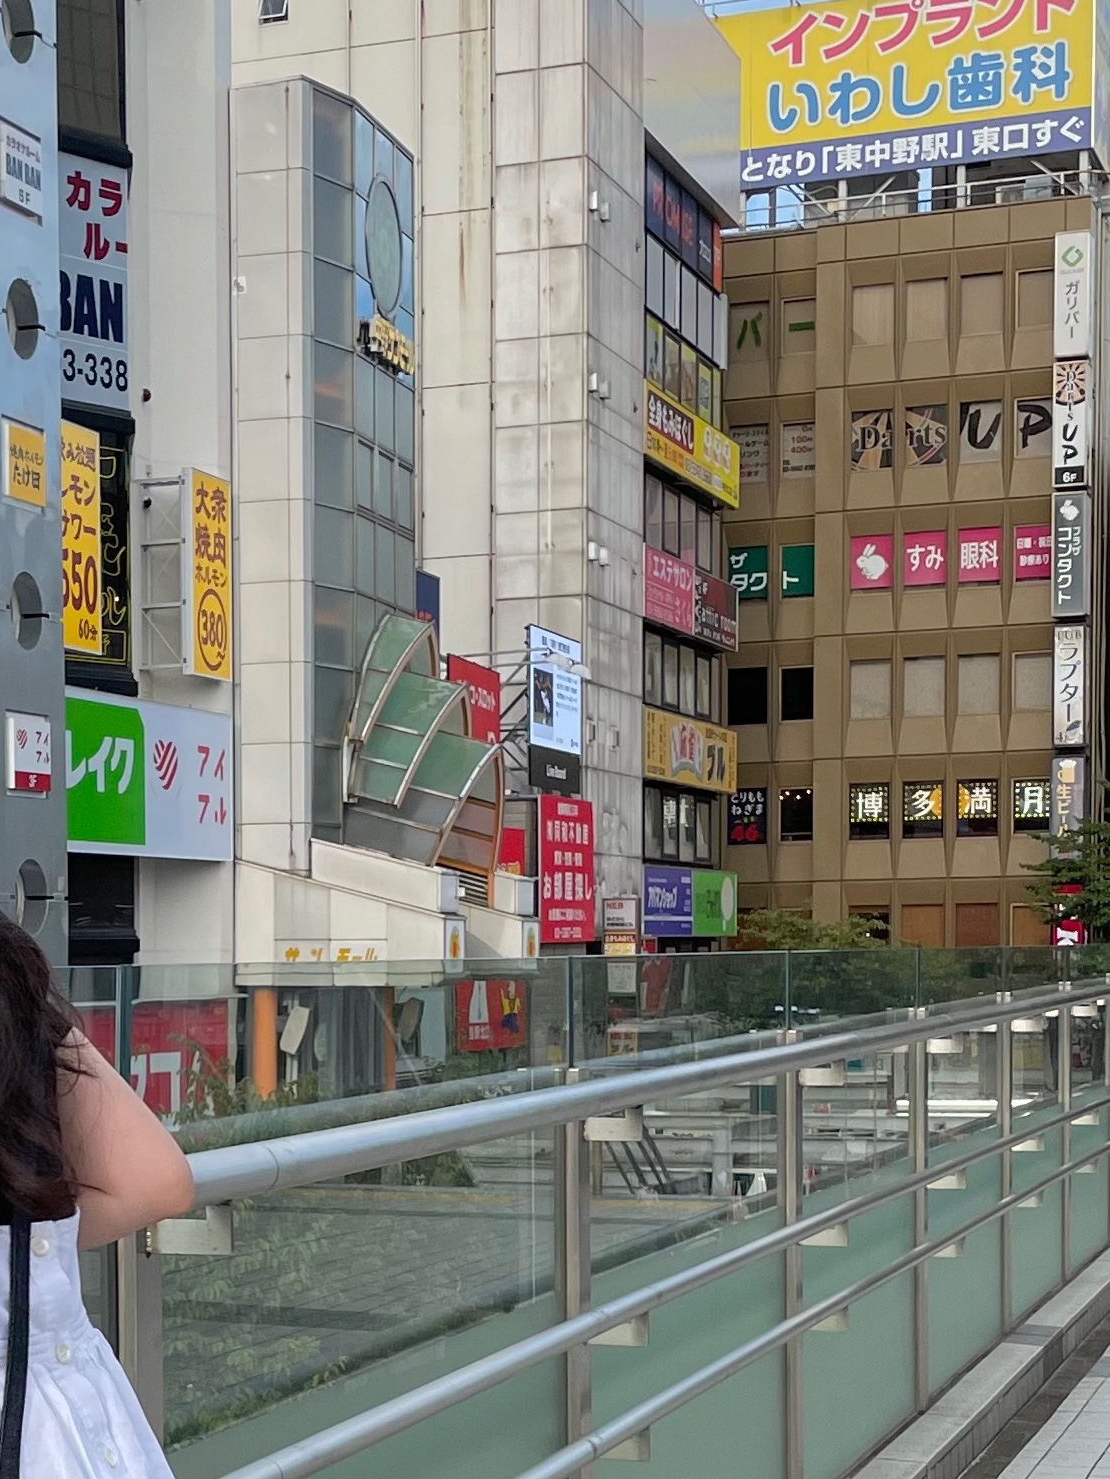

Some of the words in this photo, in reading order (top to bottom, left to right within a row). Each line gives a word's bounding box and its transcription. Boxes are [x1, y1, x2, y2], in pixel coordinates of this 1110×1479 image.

[769, 0, 1074, 65] インプラント
[769, 41, 1070, 132] いわし歯科
[6, 152, 23, 182] BAN
[25, 162, 41, 191] BAN
[66, 170, 123, 217] カラ
[1064, 280, 1081, 339] ガリバー
[62, 348, 128, 392] 3-338
[857, 425, 947, 452] Darts
[968, 404, 1052, 450] UP
[1062, 423, 1079, 465] UP
[1062, 471, 1077, 483] 6F
[195, 481, 227, 525] 大衆
[195, 520, 227, 571] 焼肉
[730, 552, 748, 569] ザ
[907, 540, 998, 572] すみ眼科
[1057, 526, 1073, 605] コンタクト
[195, 561, 227, 588] ホルモン
[1060, 642, 1081, 723] ラプター
[197, 745, 226, 782] アイ
[197, 794, 228, 827] フル
[857, 786, 1044, 819] 博多満月
